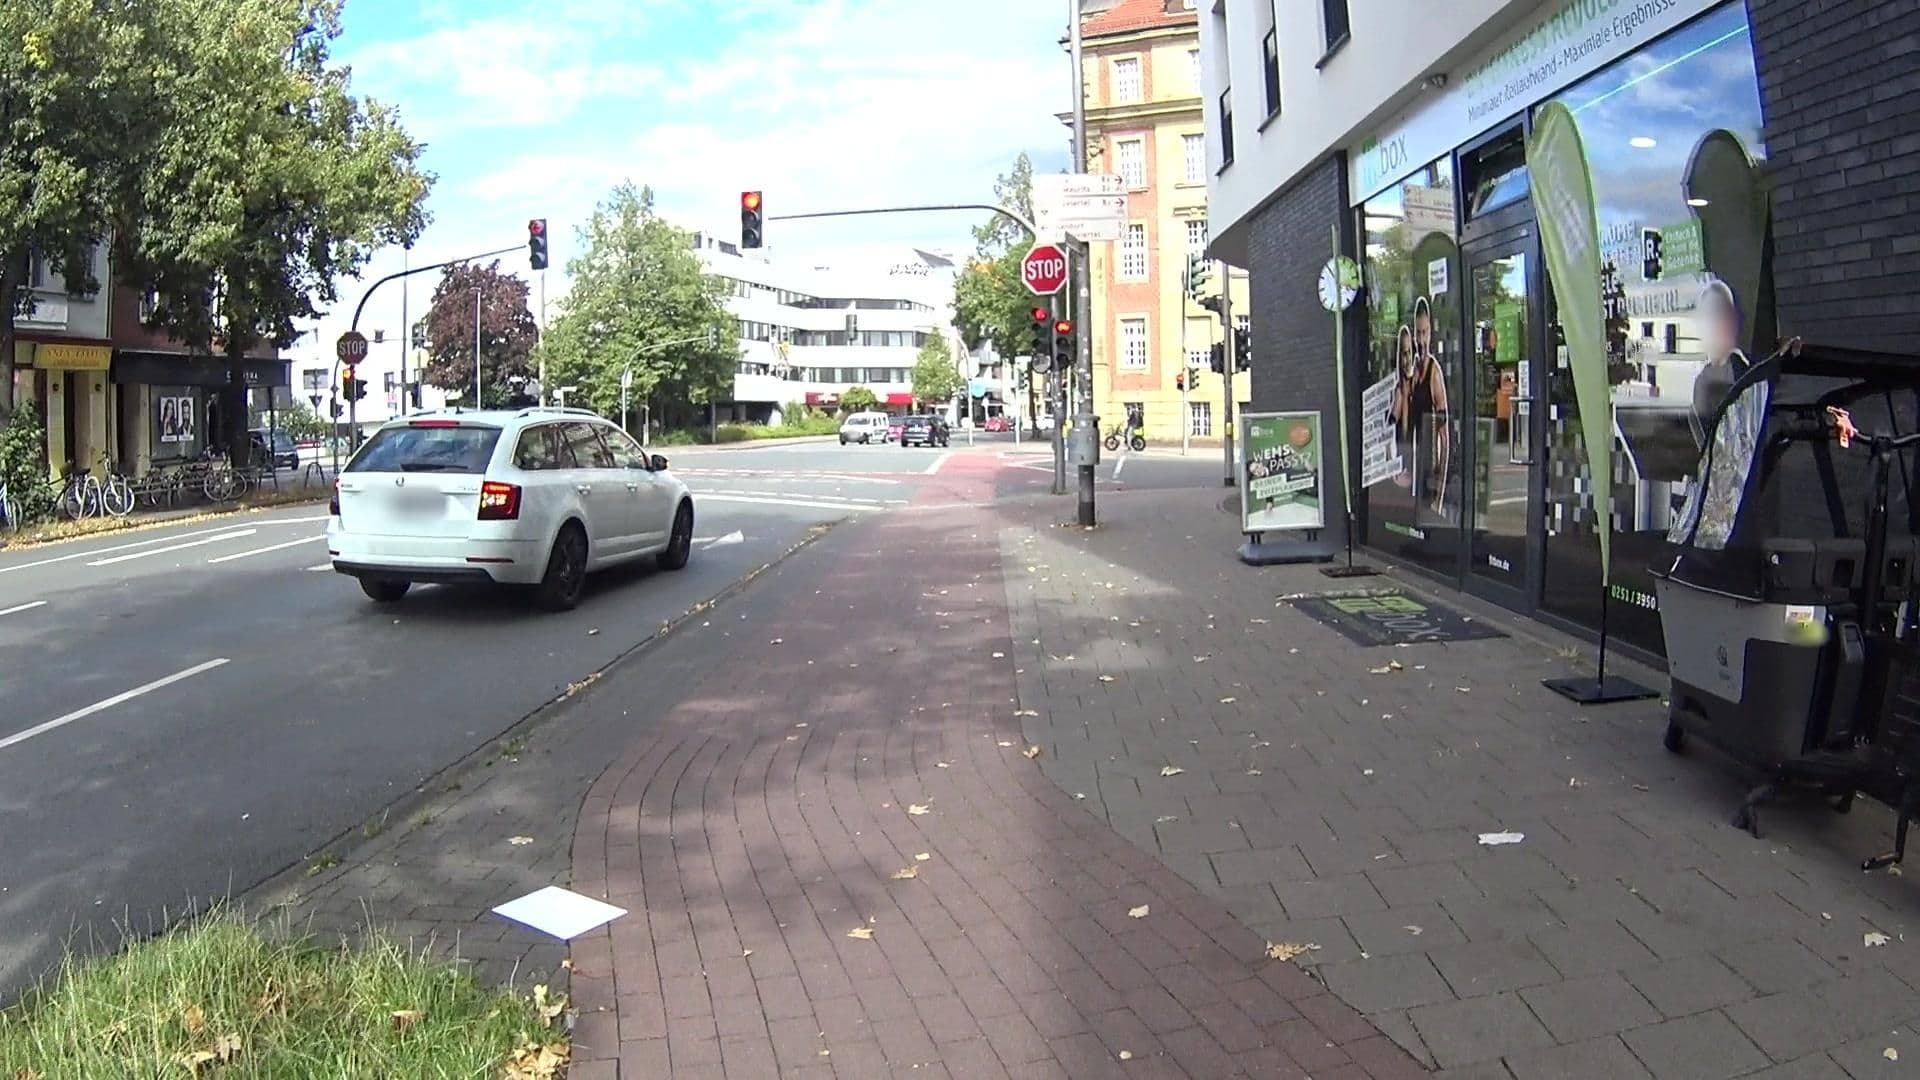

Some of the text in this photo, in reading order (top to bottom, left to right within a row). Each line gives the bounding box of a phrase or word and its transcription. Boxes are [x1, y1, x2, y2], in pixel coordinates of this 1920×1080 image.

[1026, 258, 1063, 280] STOP
[340, 340, 366, 356] STOP
[1611, 585, 1629, 602] 0251
[1636, 592, 1660, 611] 3950
